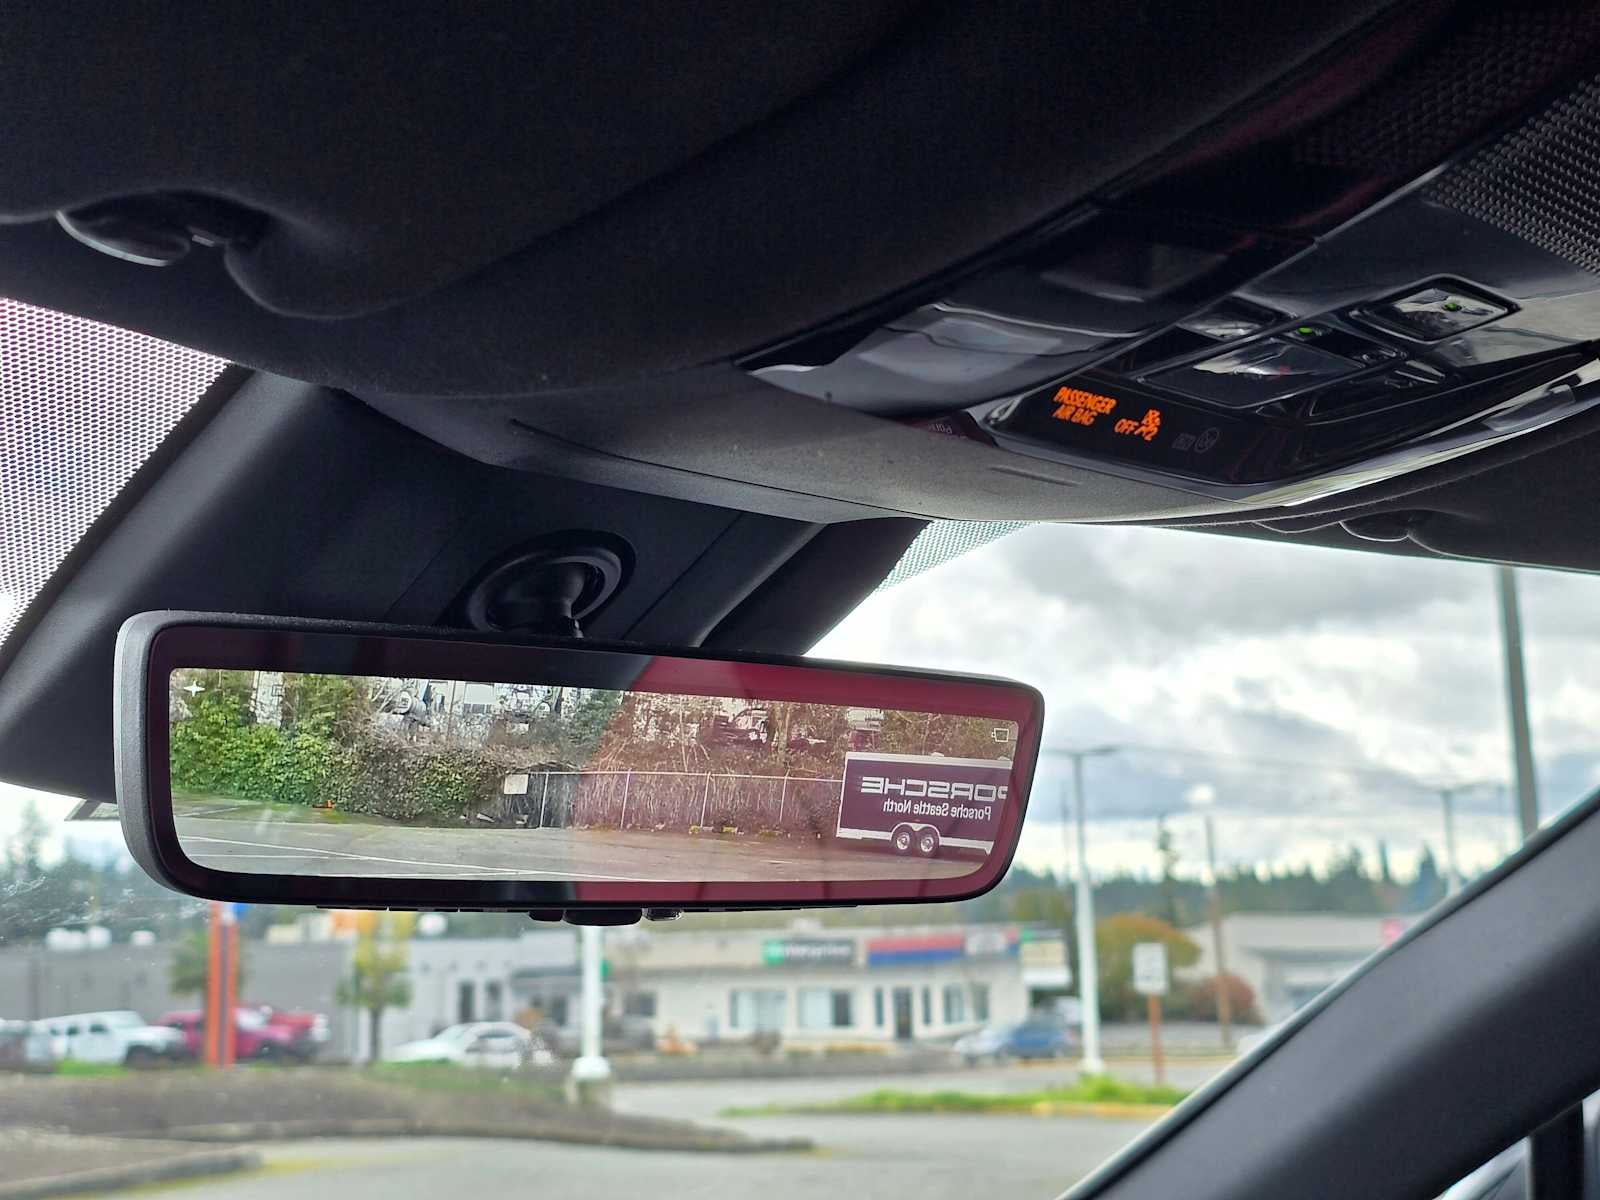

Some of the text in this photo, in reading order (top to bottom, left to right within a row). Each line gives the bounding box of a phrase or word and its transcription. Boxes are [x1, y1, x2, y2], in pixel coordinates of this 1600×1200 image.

[1053, 386, 1117, 415] PASSENGER
[1052, 405, 1098, 426] AIR BAG
[1114, 418, 1139, 435] OFF
